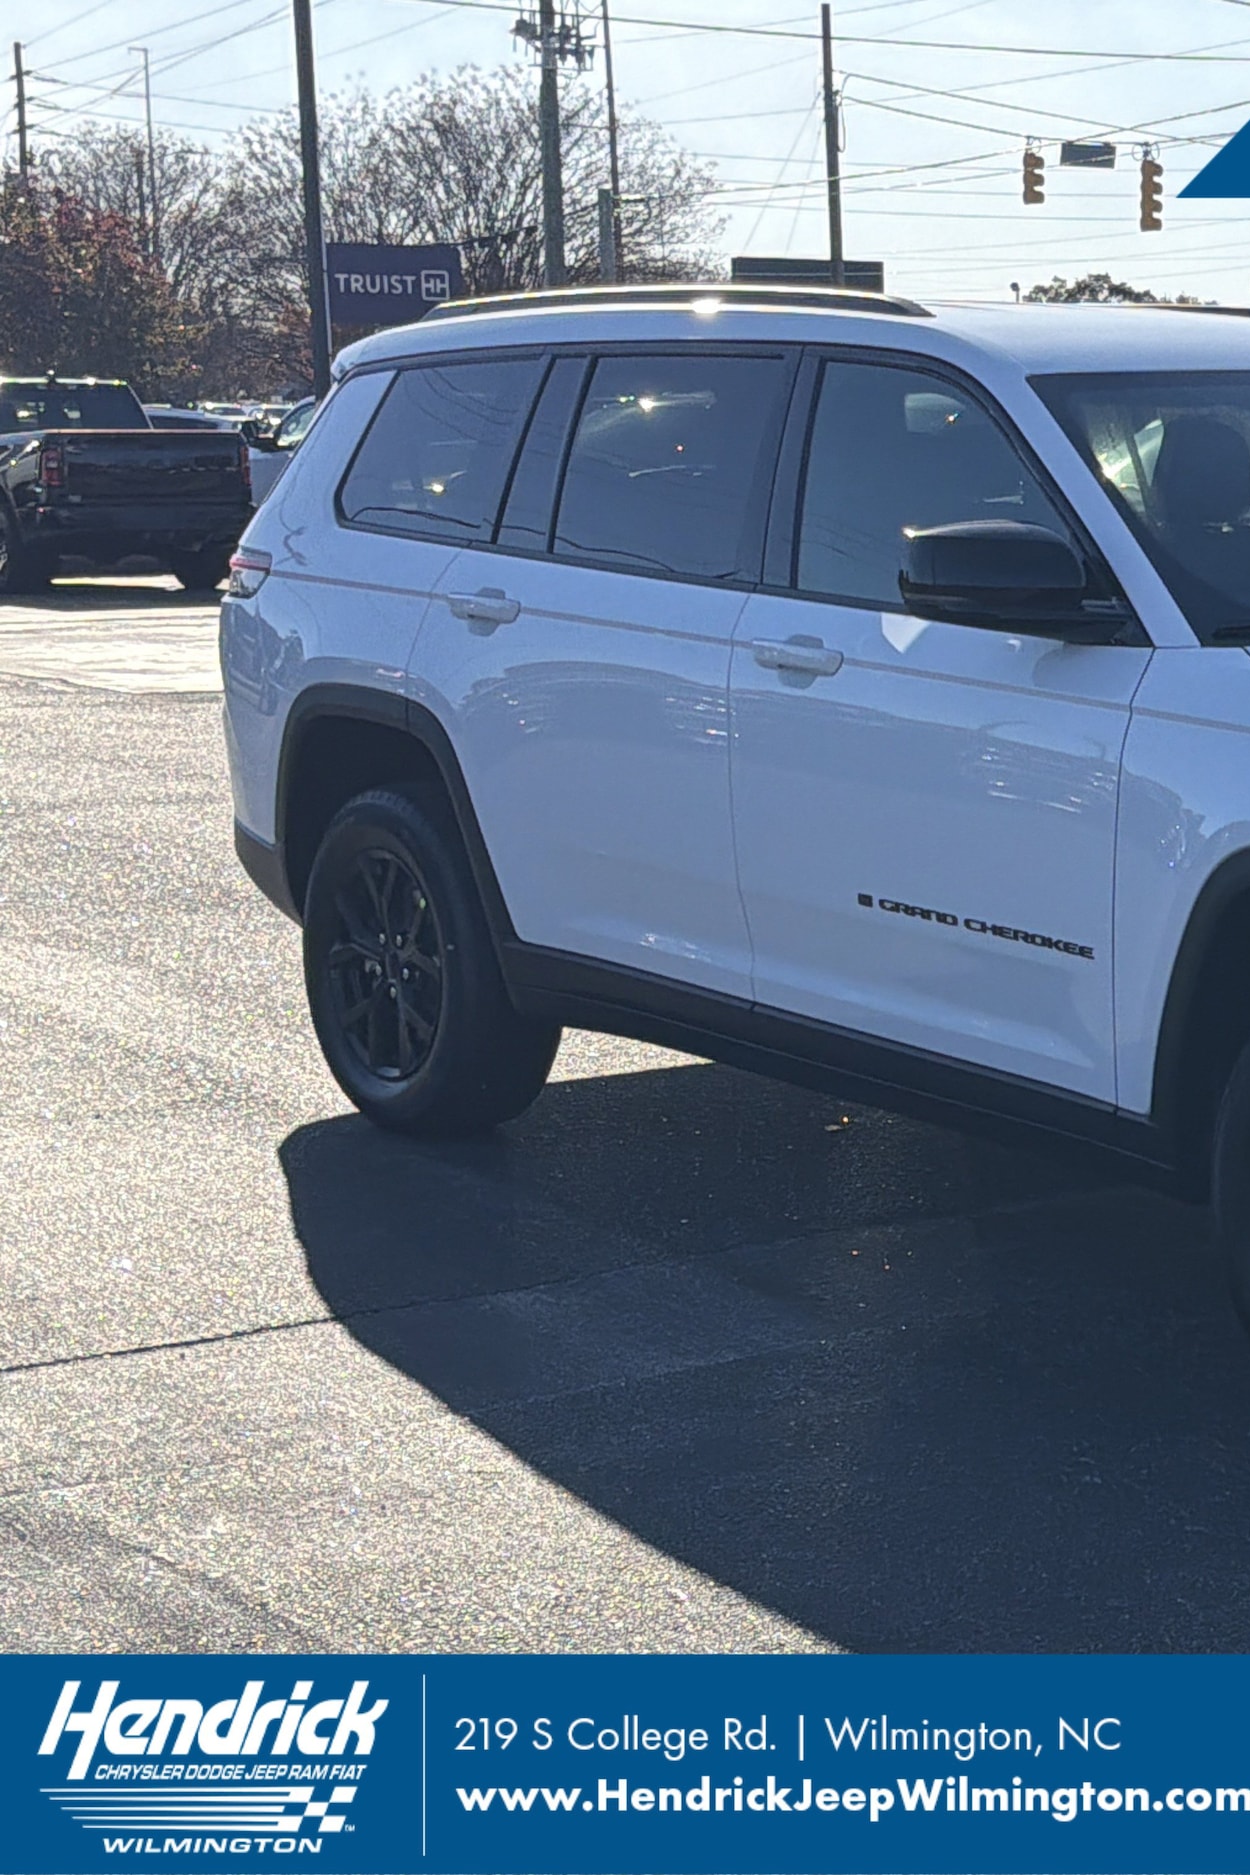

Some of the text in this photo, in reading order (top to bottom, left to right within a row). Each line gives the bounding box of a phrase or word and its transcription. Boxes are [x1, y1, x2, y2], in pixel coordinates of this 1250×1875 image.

[334, 273, 417, 295] TRUIST
[878, 898, 1096, 961] GRAND CHEROKEE
